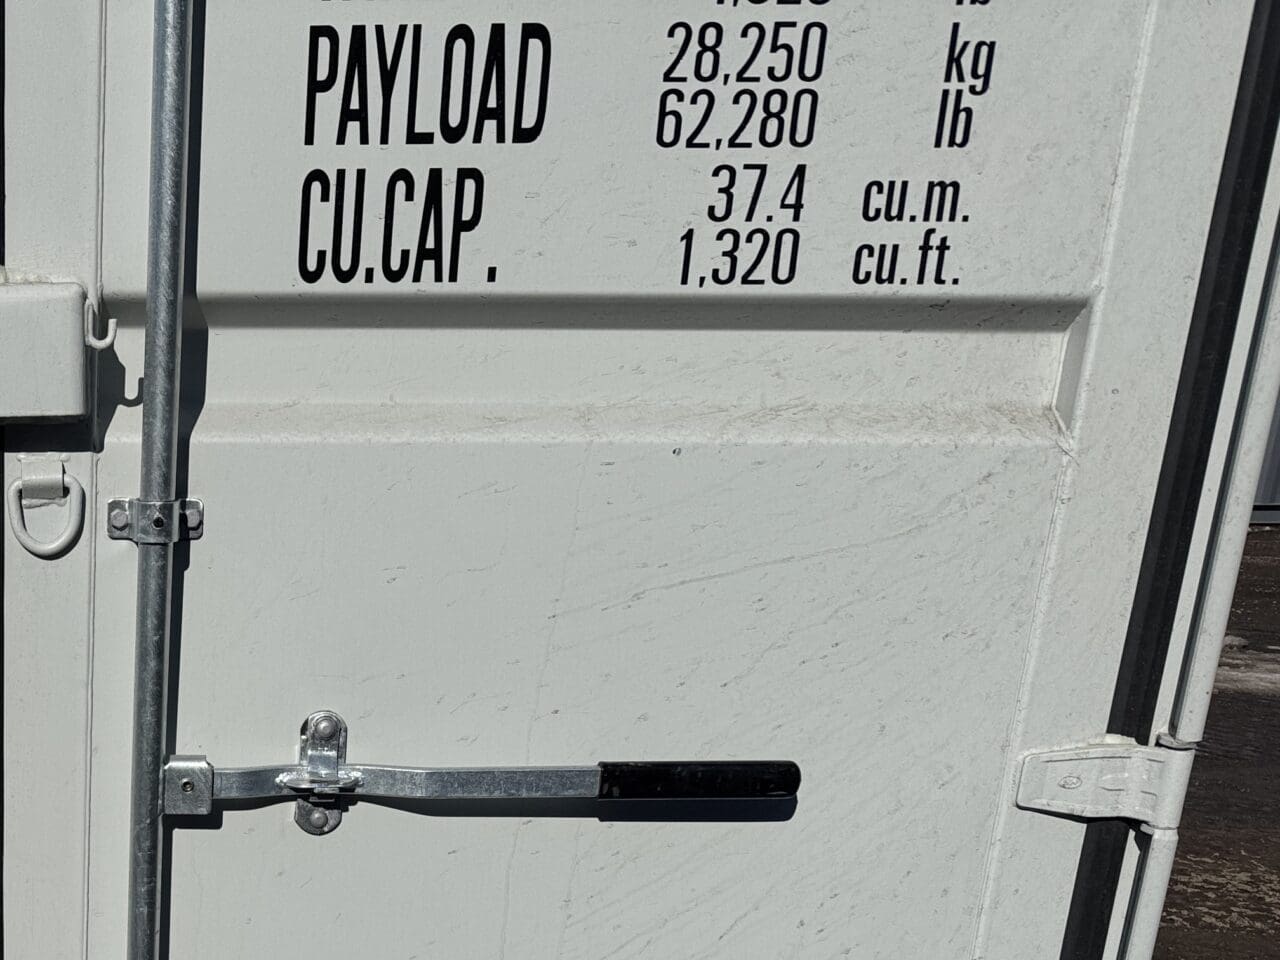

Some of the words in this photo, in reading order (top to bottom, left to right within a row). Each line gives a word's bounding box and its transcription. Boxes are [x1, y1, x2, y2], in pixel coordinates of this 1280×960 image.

[303, 22, 552, 146] PAYLOAD
[662, 20, 828, 86] 28,250
[943, 22, 997, 96] kg
[655, 87, 820, 151] 62,280
[933, 89, 975, 149] lb
[297, 167, 498, 284] CU.CAP.
[707, 164, 807, 223] 37.4
[861, 178, 971, 223] cu.m.
[678, 227, 801, 288] 1,320
[851, 230, 961, 286] cu.ft.
